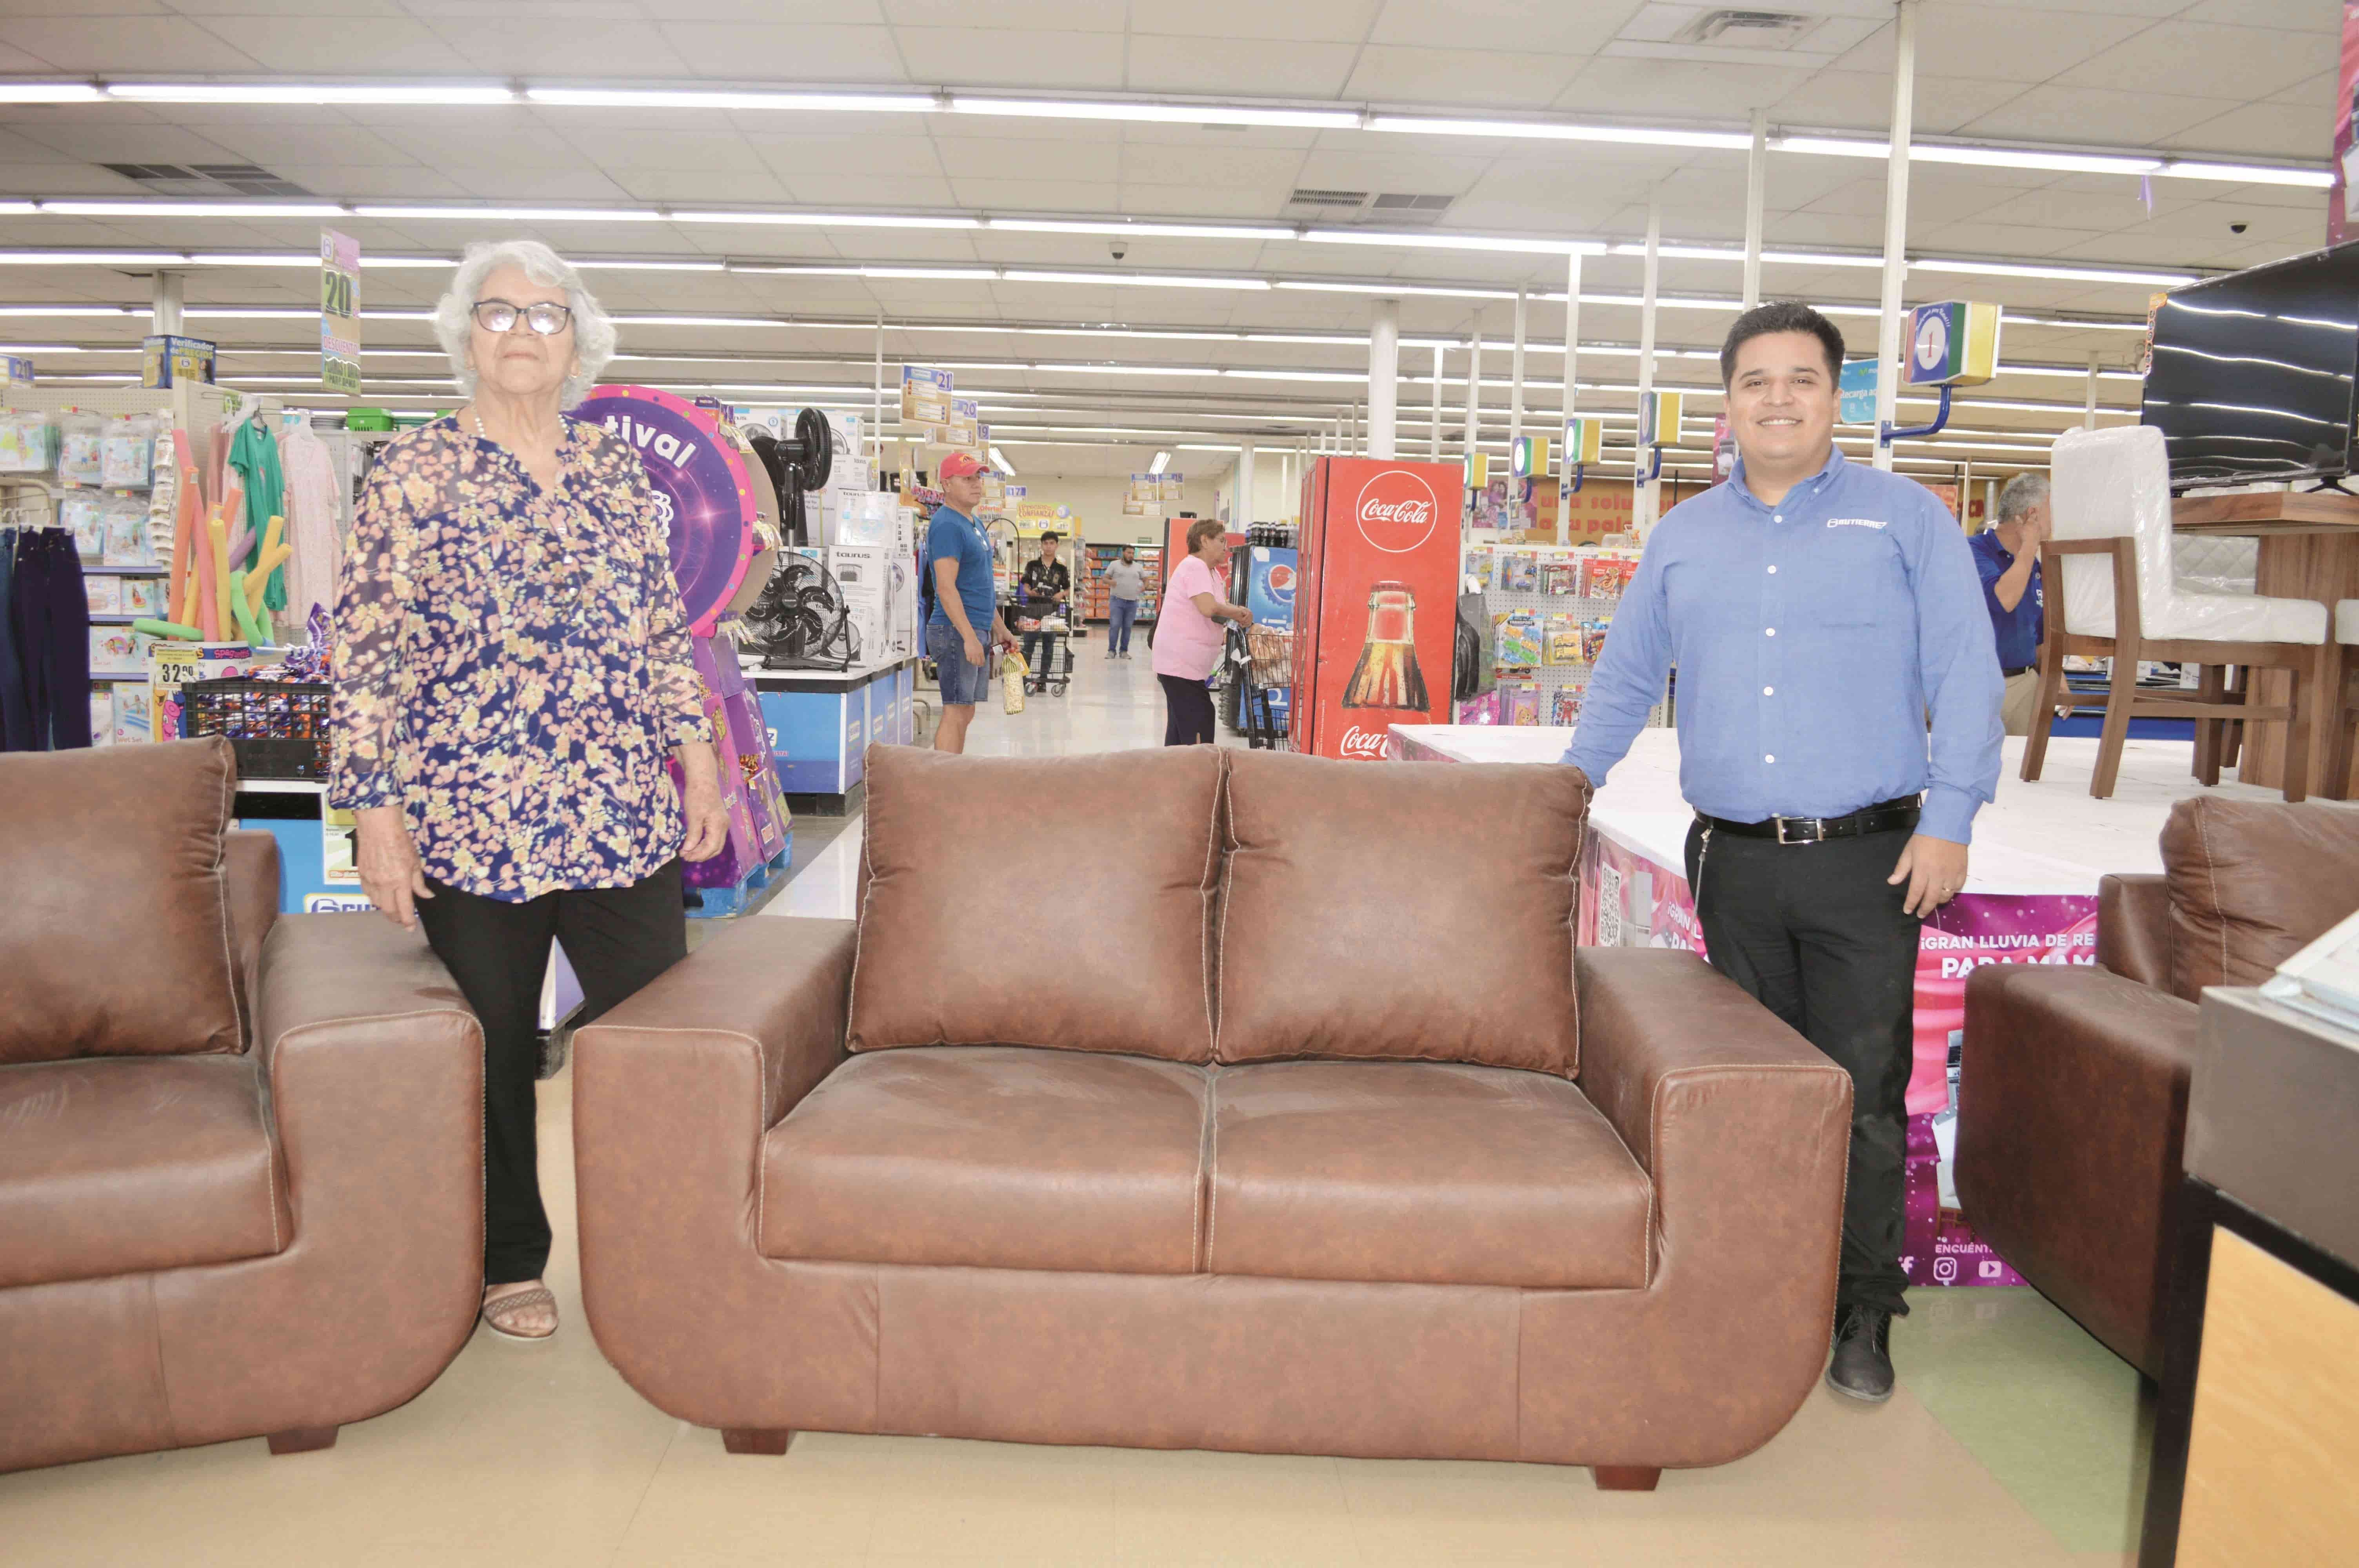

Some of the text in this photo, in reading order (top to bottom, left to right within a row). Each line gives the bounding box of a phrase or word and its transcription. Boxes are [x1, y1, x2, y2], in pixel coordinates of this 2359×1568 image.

[325, 271, 351, 318] 20
[171, 337, 214, 351] Verificador
[323, 336, 358, 356] DESCUENTO
[1927, 332, 1933, 358] 1
[938, 372, 953, 389] 21
[1361, 498, 1432, 524] Coca-Cola
[1979, 935, 2040, 949] LLUVIA
[2045, 934, 2068, 947] DE
